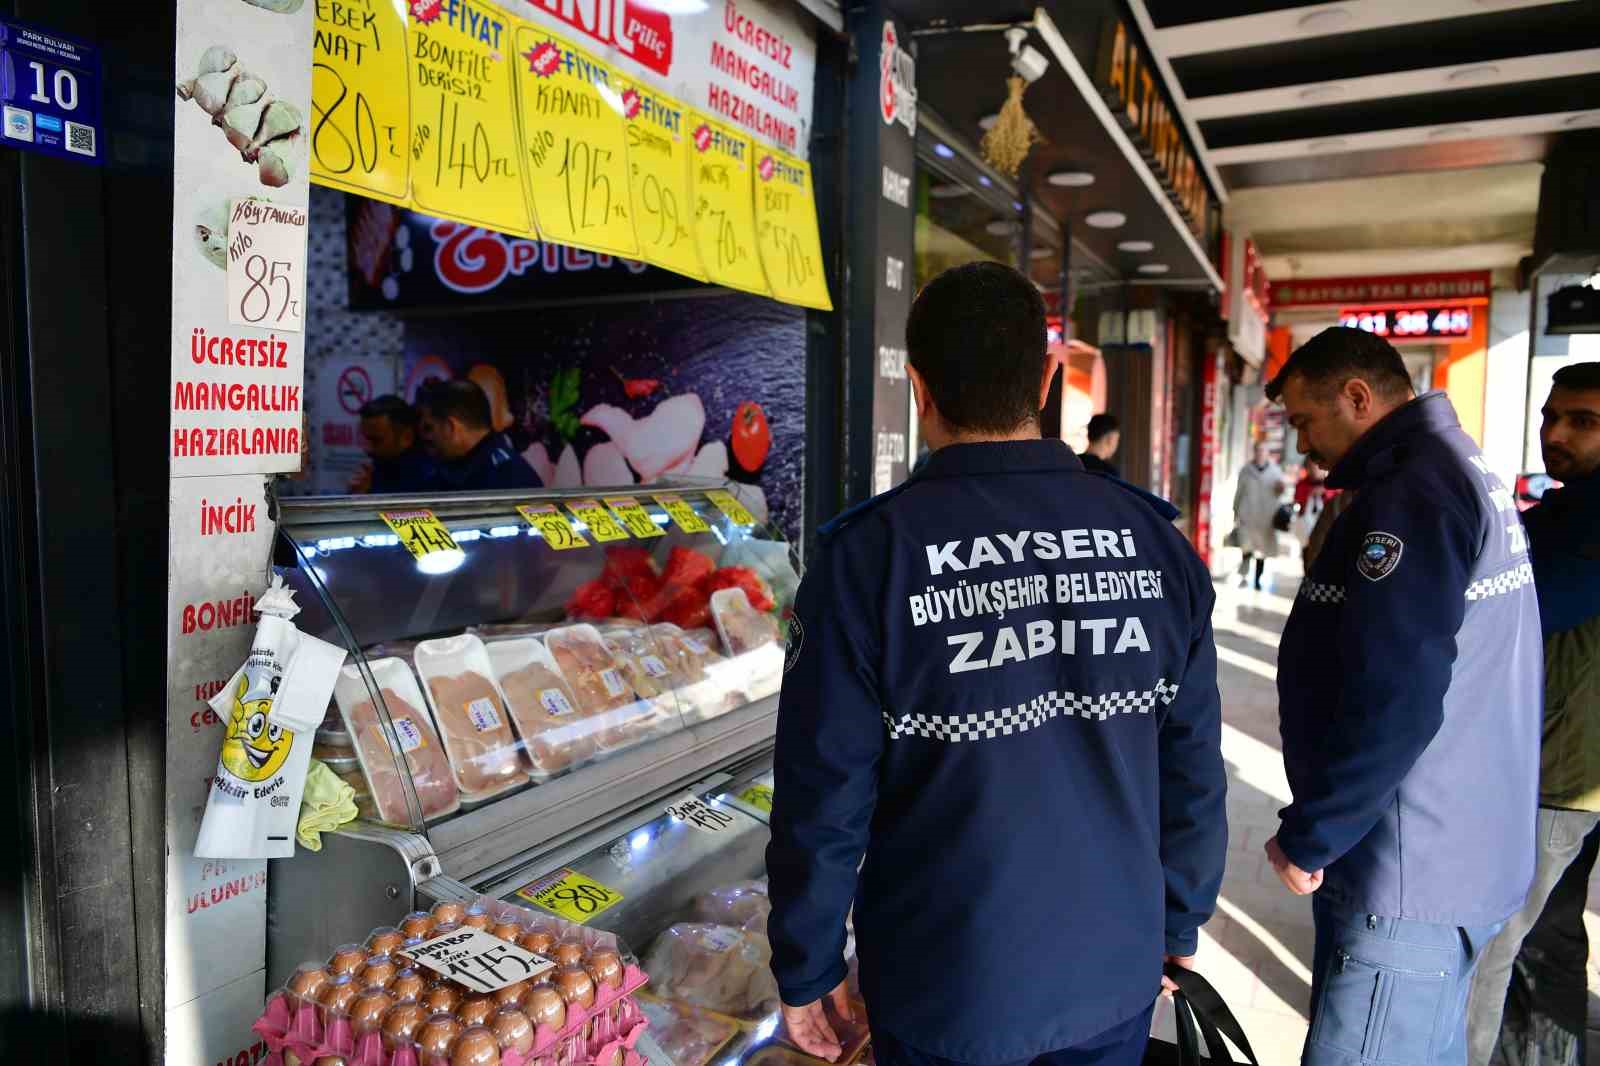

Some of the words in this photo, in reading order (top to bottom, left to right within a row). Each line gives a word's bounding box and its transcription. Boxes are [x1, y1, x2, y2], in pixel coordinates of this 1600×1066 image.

[22, 30, 42, 42] PARK
[43, 37, 75, 52] BULVARI
[447, 0, 503, 49] FİYAT
[626, 18, 666, 60] Piliç
[724, 0, 792, 70] ÜCRETSİZ
[30, 62, 78, 111] 10
[710, 41, 798, 113] MANGALLIK
[311, 64, 378, 174] 80
[536, 84, 600, 120] KANAT
[643, 94, 681, 133] FİYAT
[707, 82, 797, 150] HAZIRLANIR
[435, 92, 490, 189] 140
[490, 158, 516, 177] TL
[557, 137, 612, 234] 125
[642, 173, 679, 247] 99
[709, 209, 737, 268] 70
[241, 254, 291, 322] 85
[191, 327, 288, 368] ÜCRETSİZ
[174, 381, 300, 412] MANGALLIK
[174, 427, 300, 457] HAZIRLANIR
[200, 497, 256, 536] İNCİK
[543, 520, 573, 546] 99
[925, 528, 1137, 576] KAYSERİ
[909, 573, 1049, 627] BÜYÜKŞEHİR
[1055, 568, 1164, 604] BELEDİYESİ
[946, 616, 1151, 674] ZABITA
[253, 776, 285, 799] Ederiz
[554, 884, 609, 913] 80
[447, 945, 532, 989] 175
